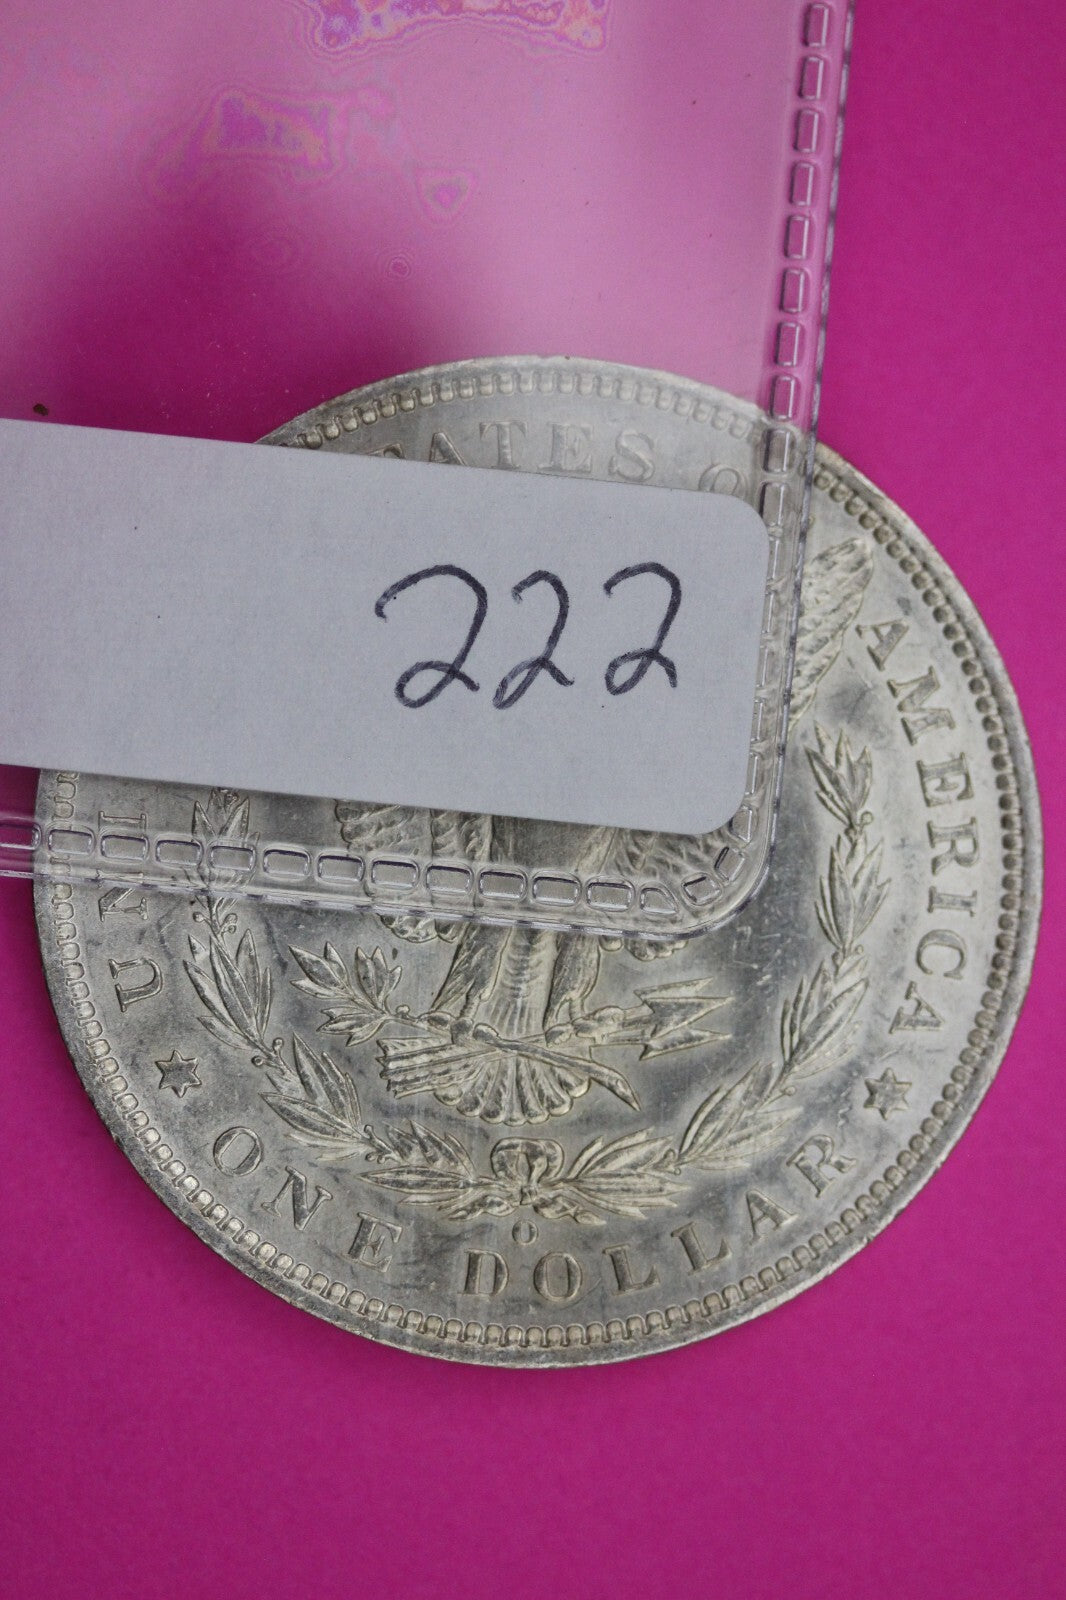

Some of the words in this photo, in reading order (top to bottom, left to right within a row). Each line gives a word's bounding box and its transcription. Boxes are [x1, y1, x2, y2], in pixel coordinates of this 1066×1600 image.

[374, 561, 683, 710] 222
[98, 810, 165, 1013] UNI
[366, 420, 656, 481] ATES
[855, 618, 981, 1036] AMERICA
[212, 1125, 404, 1274] ONE
[457, 1133, 858, 1301] DOLLAR
